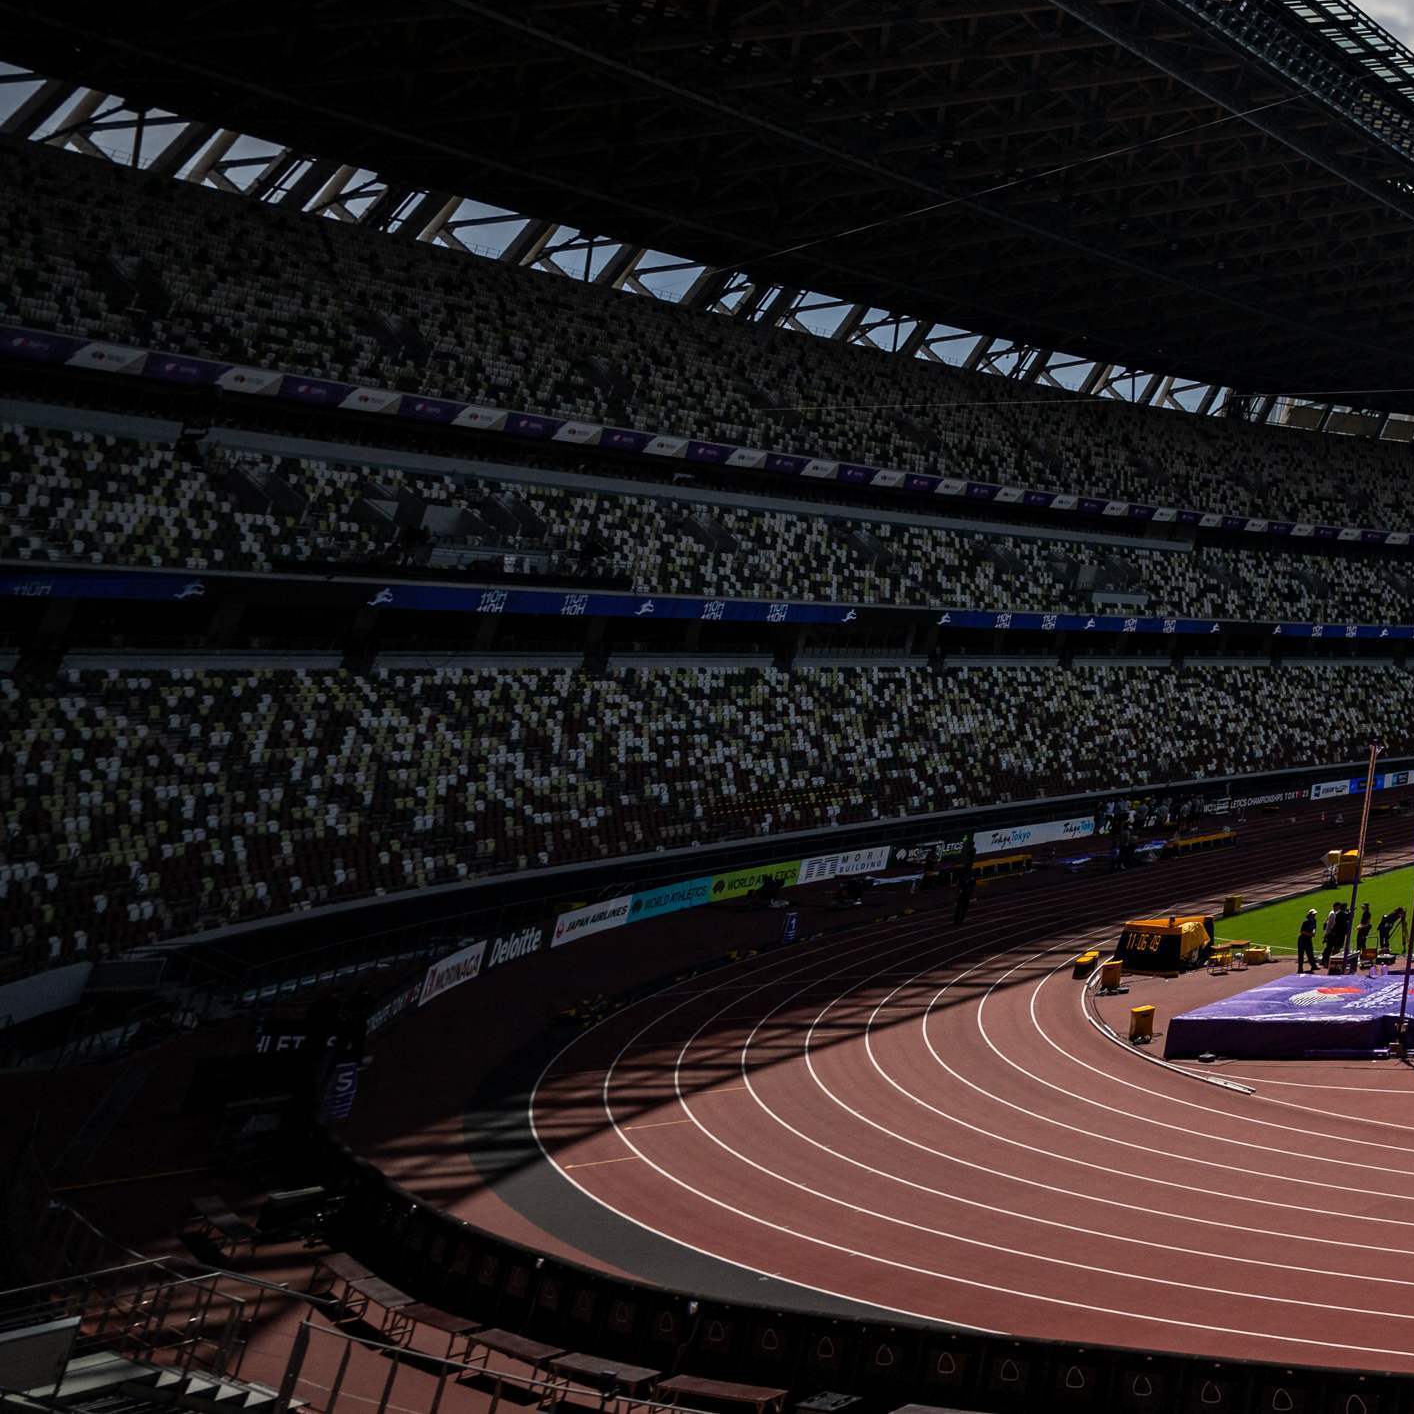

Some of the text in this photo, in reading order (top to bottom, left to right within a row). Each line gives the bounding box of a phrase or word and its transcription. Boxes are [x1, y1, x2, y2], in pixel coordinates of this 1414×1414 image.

[839, 861, 882, 873] BUILDING
[728, 875, 755, 891] WORLD
[644, 886, 708, 912] WORLD ATHLETICS
[566, 905, 627, 933] JAPAN AIRLINES
[488, 926, 542, 968] Deloitte
[336, 1071, 354, 1092] 5
